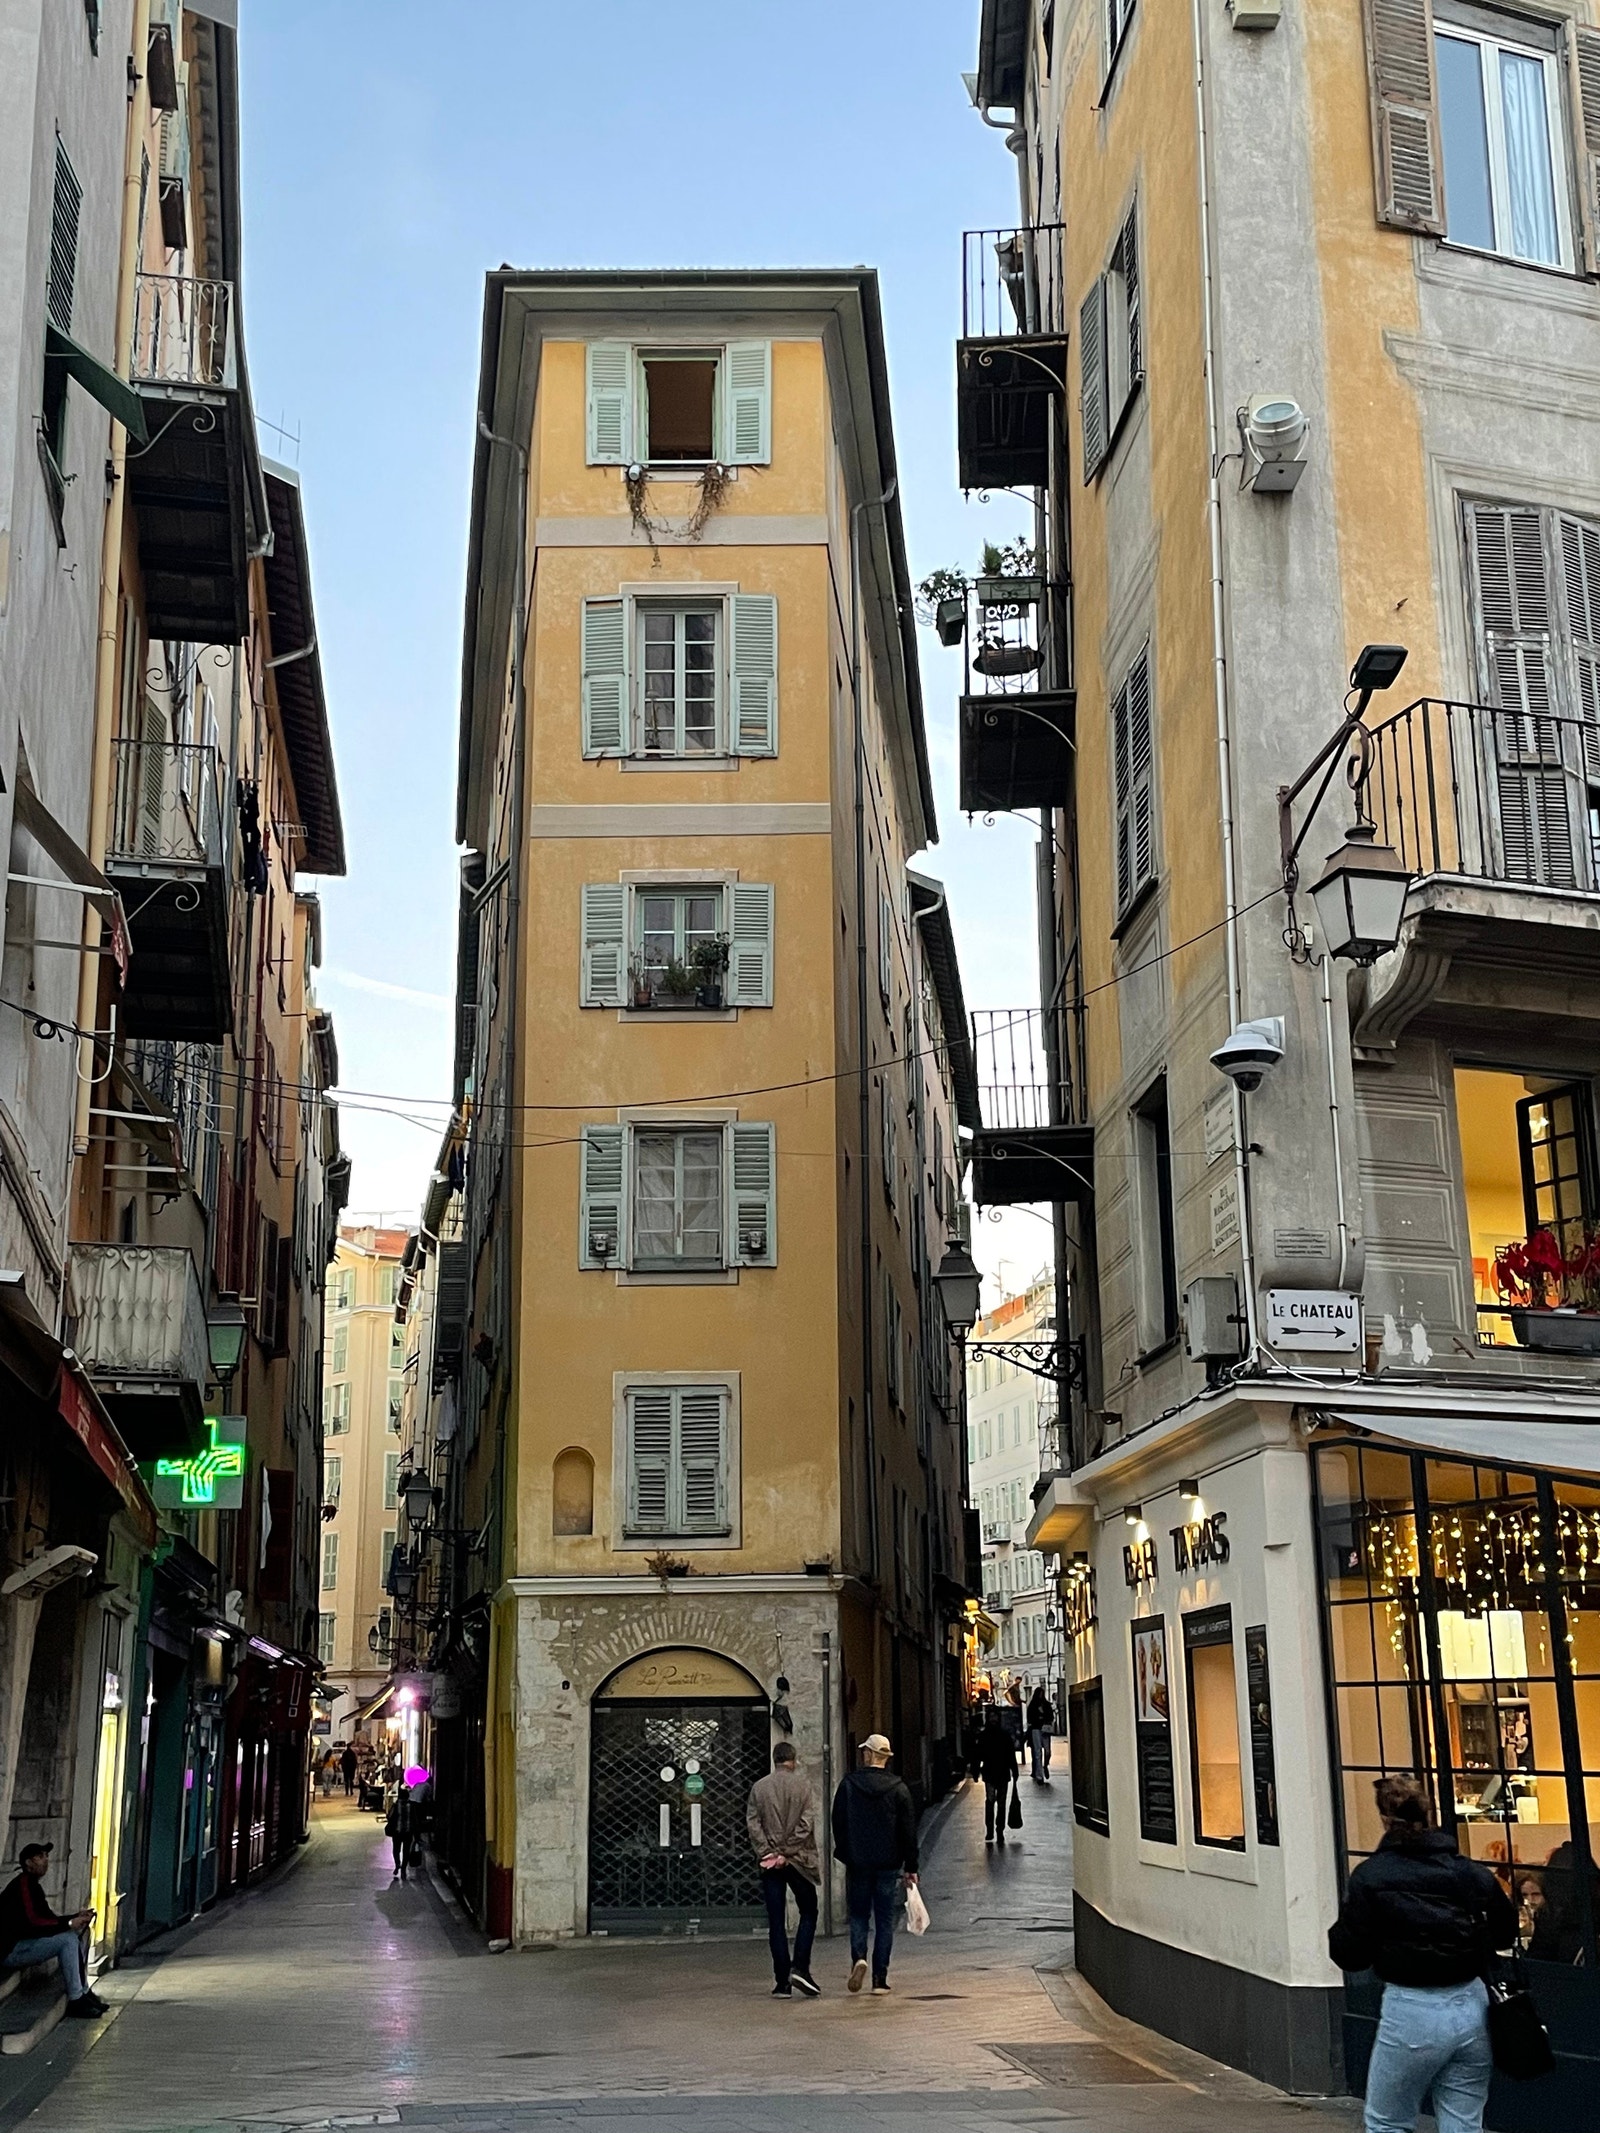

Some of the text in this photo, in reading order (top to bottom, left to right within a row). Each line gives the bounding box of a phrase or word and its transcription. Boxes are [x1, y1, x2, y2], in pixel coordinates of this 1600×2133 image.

[1290, 1303, 1353, 1319] CHATEAU
[1122, 1511, 1230, 1588] BAR TAPAS
